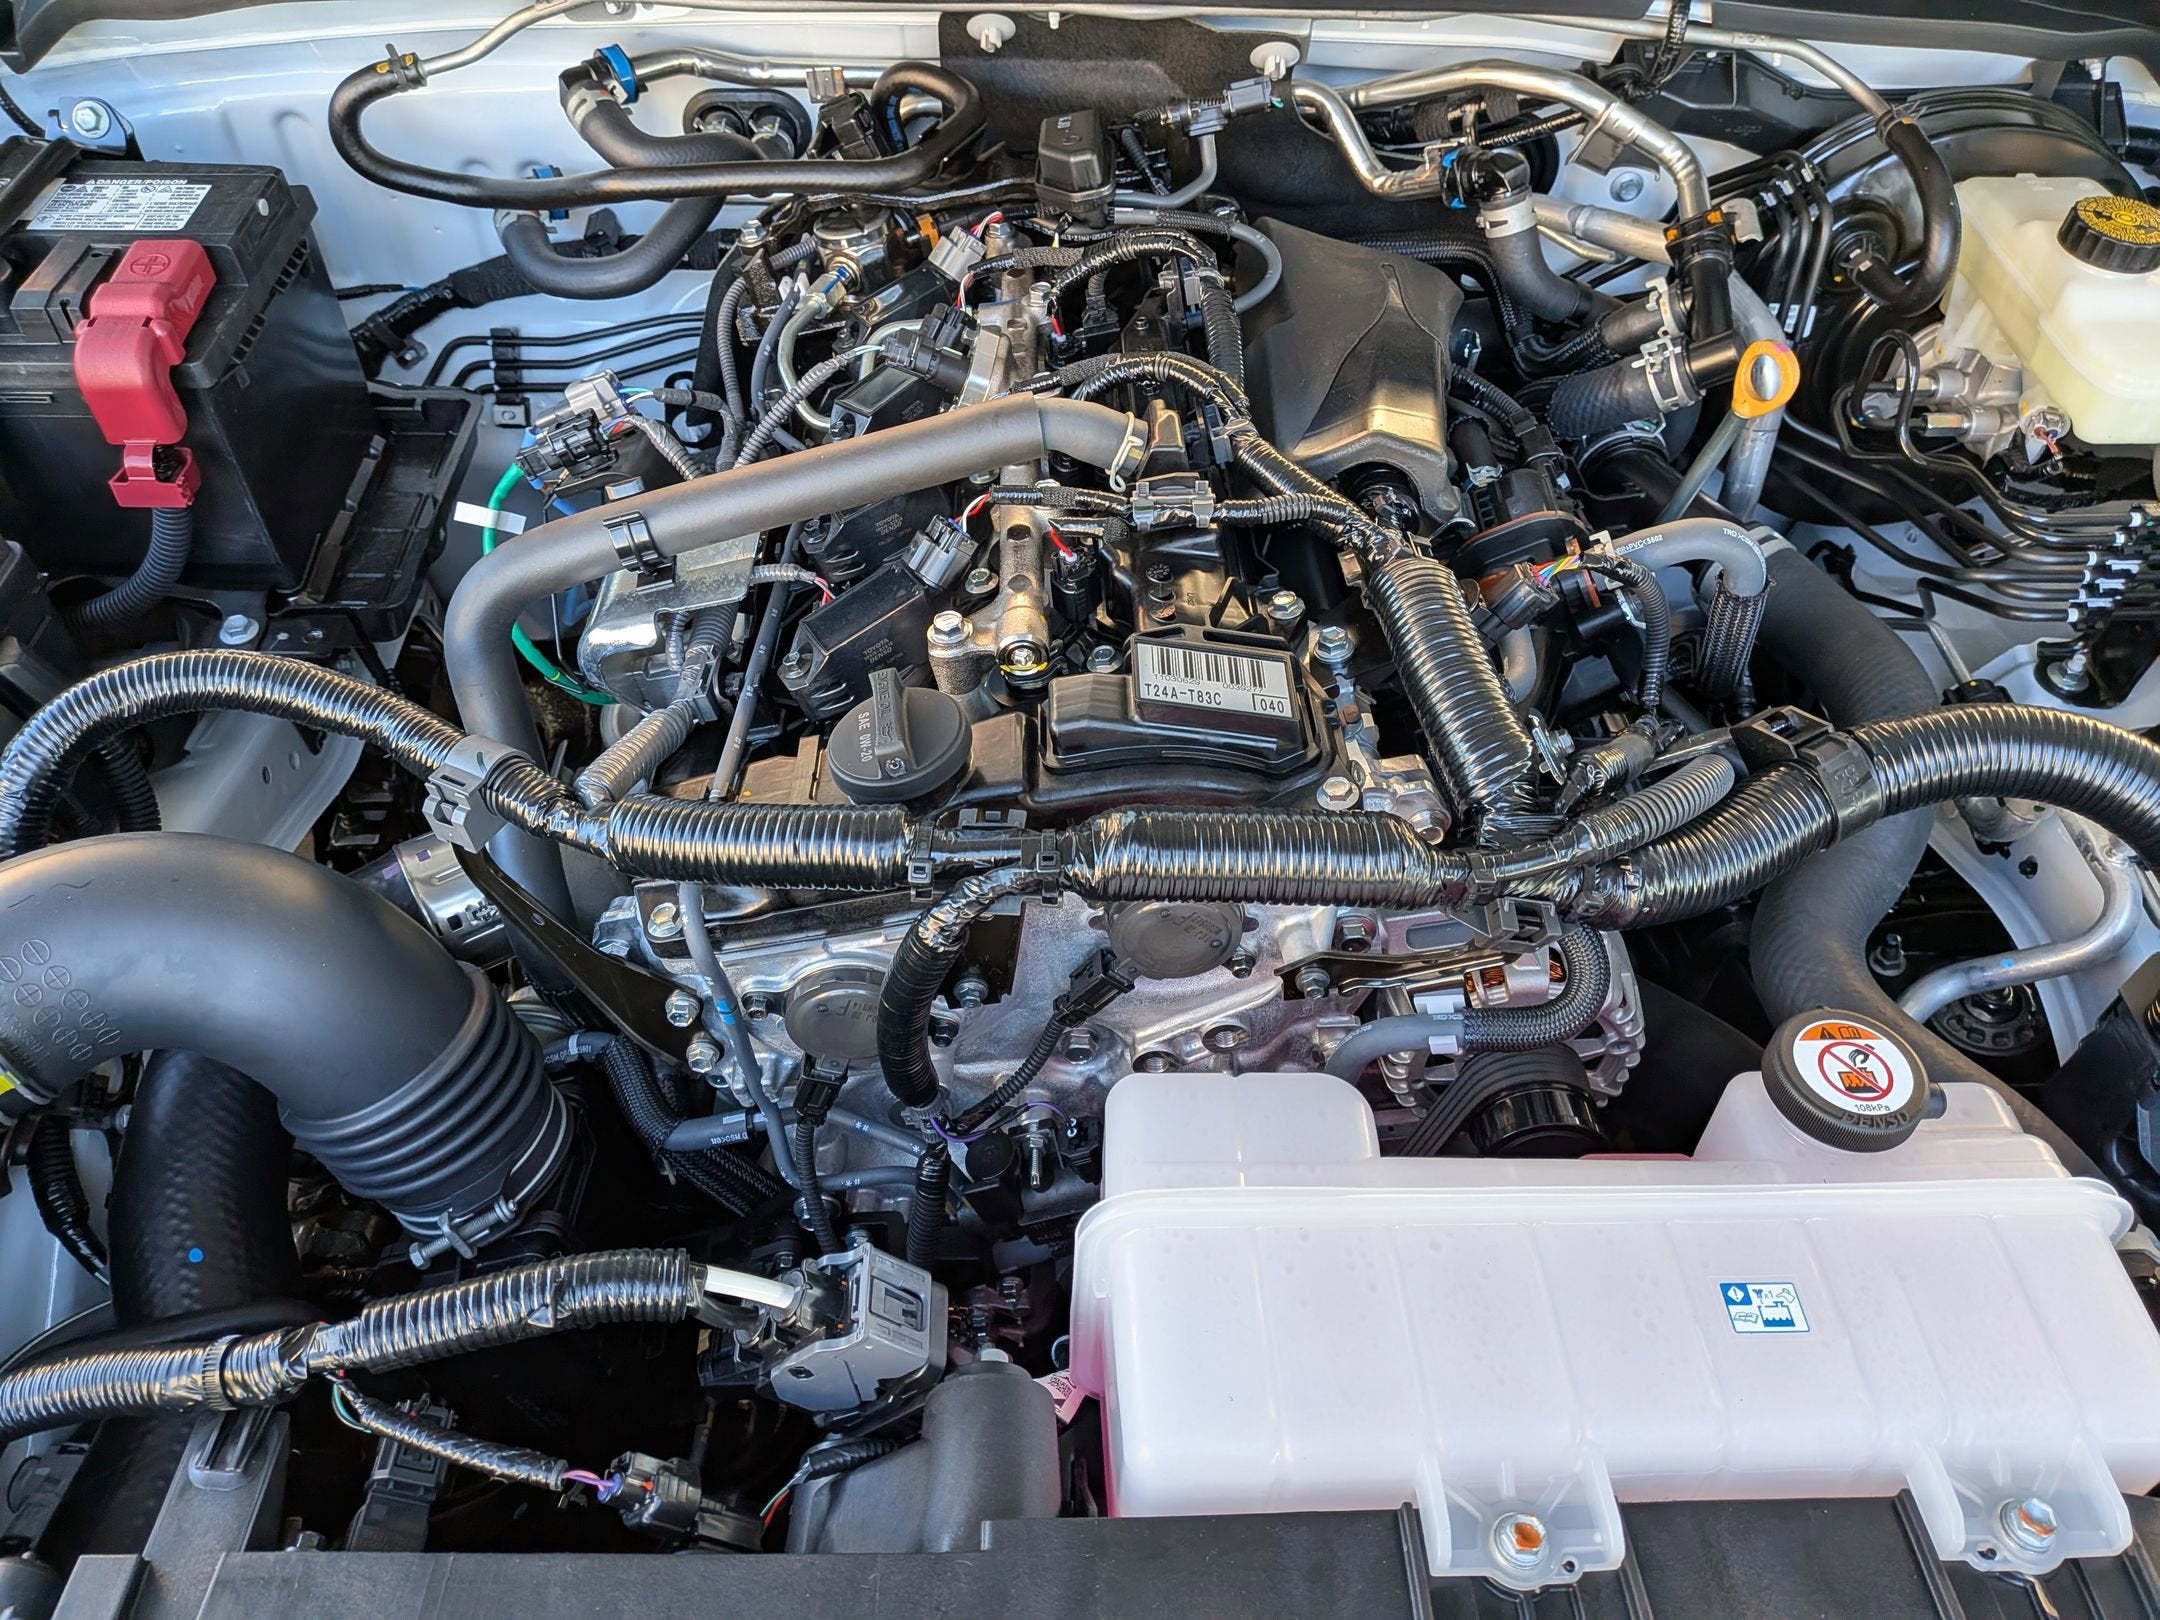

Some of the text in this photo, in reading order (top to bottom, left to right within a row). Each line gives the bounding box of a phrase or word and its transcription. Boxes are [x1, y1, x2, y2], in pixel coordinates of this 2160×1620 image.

[873, 513, 900, 528] TOYOTA
[862, 638, 890, 656] TOYOTA
[869, 646, 893, 664] DENSO
[1222, 682, 1264, 693] 0039277
[1145, 683, 1285, 714] T24A-T83C 040
[878, 701, 891, 718] OIL
[858, 711, 870, 731] SAE
[1854, 1103, 1891, 1113] 108kPa
[1840, 1109, 1910, 1130] DENSO
